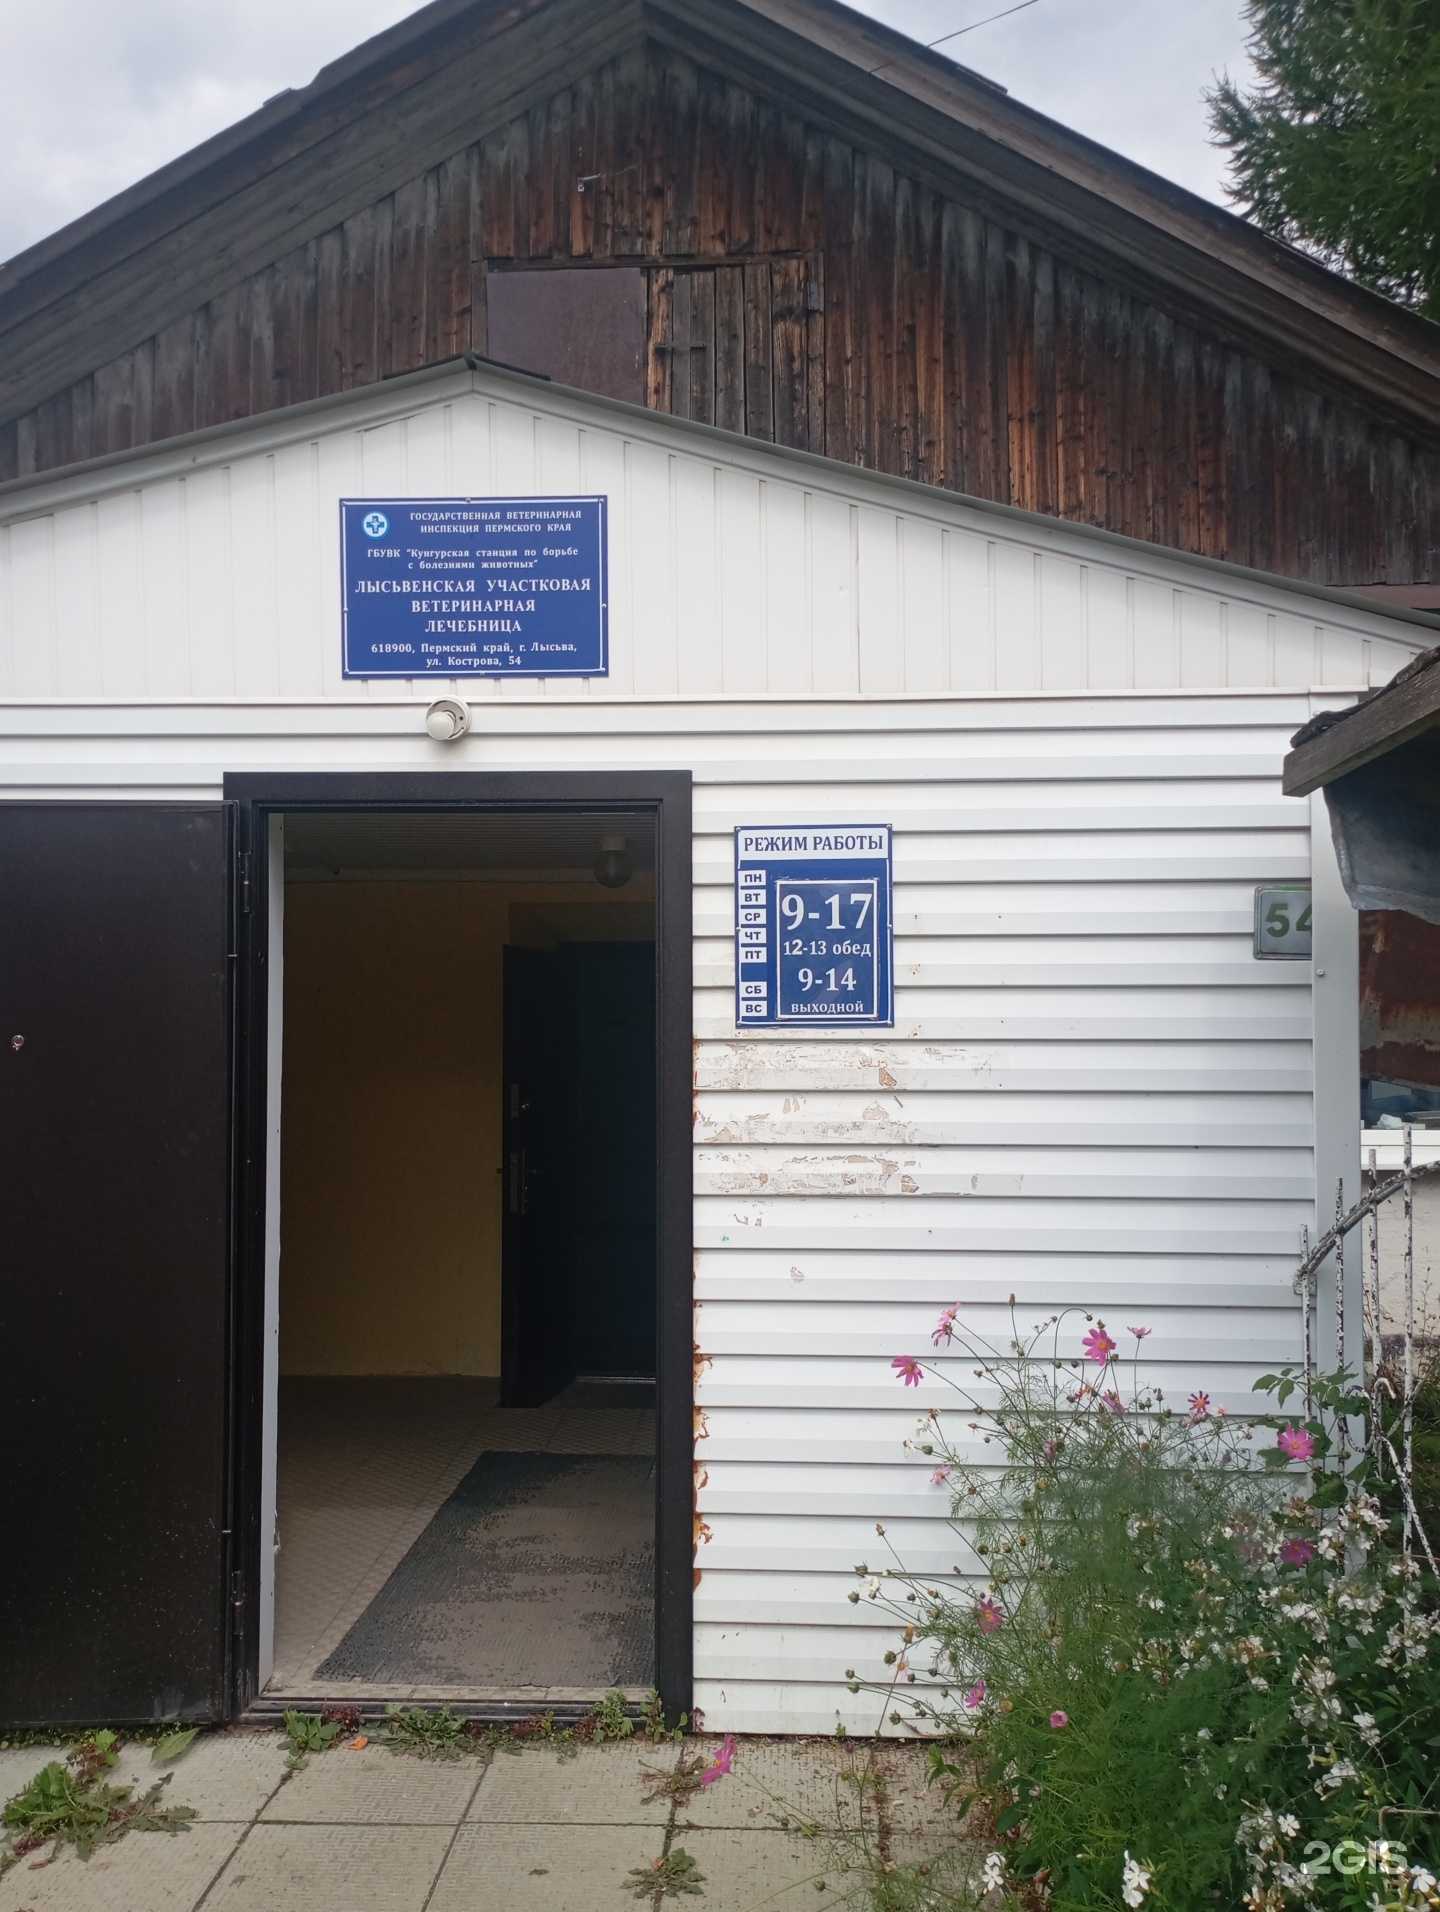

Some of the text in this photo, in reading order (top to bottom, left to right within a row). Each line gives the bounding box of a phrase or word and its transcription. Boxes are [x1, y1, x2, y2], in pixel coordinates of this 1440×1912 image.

[410, 510, 582, 522] ГОСУДАРСТВЕННАЯ ВЕТЕРИНАРНАЯ
[420, 523, 571, 534] ИНСПЕКЦИЯ ПЕРМСКОГО КРАЯ
[368, 549, 400, 558] ГБУВК
[476, 548, 518, 558] станция
[524, 548, 536, 556] по
[543, 547, 578, 557] борьбе
[419, 560, 475, 569] болезнями
[355, 578, 591, 593] ЛЫСЬВЕНСКАЯ УЧАСТКОВАЯ
[411, 600, 535, 613] ВЕТЕРИНАРНАЯ
[425, 620, 522, 634] ЛЕЧЕБНИЦА
[371, 644, 415, 654] 618900,
[421, 643, 477, 654] Пермский
[483, 642, 513, 654] край,
[531, 642, 577, 653] Лысьва,
[426, 656, 522, 668] ул. Кострова, 54
[744, 835, 883, 851] РЕЖИМ РАБОТЫ
[744, 874, 762, 883] ПН
[744, 893, 761, 902] ВТ
[744, 912, 760, 921] СР
[781, 893, 873, 930] 9-17
[745, 932, 761, 940] ЧТ
[783, 939, 872, 957] 12-13 обед
[745, 951, 762, 960] ПТ
[798, 968, 857, 991] 9-14
[745, 985, 762, 994] СБ
[745, 1004, 762, 1013] ВС
[791, 1001, 864, 1014] выходной
